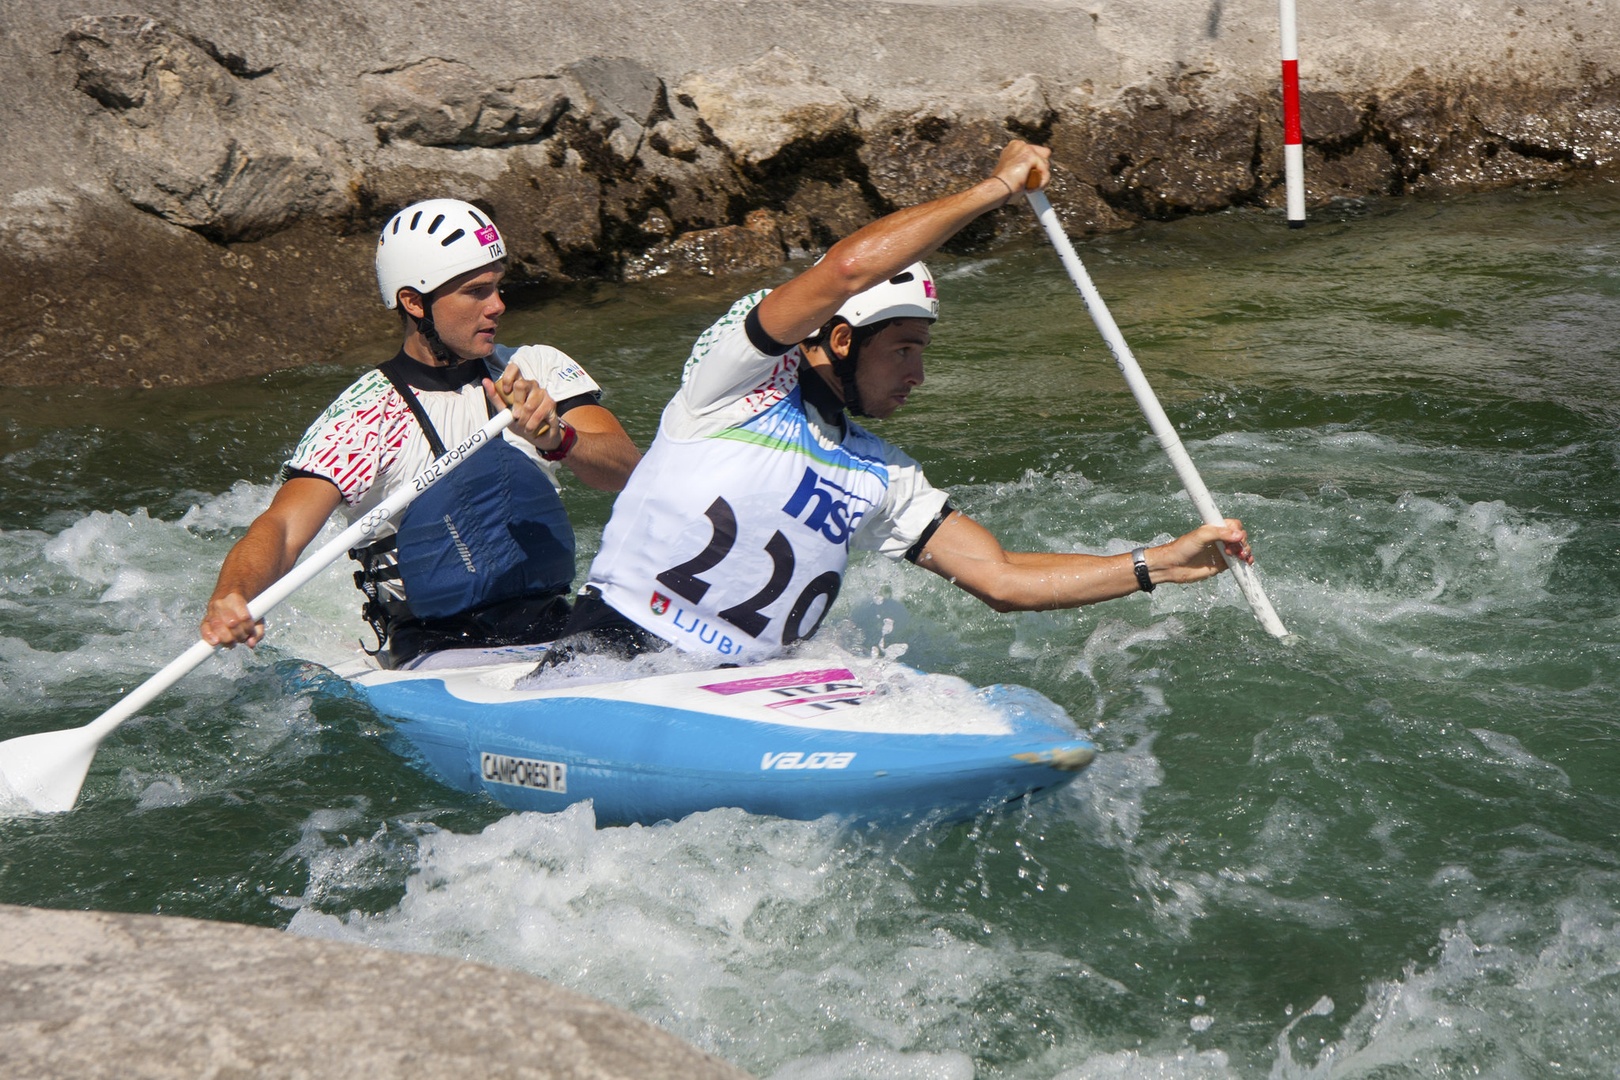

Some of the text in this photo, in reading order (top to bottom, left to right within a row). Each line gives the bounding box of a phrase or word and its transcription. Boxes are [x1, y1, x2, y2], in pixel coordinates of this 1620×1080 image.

[488, 243, 503, 258] ITA
[412, 428, 489, 492] London 2012
[656, 496, 841, 646] 220
[483, 755, 551, 789] CAMPORESI
